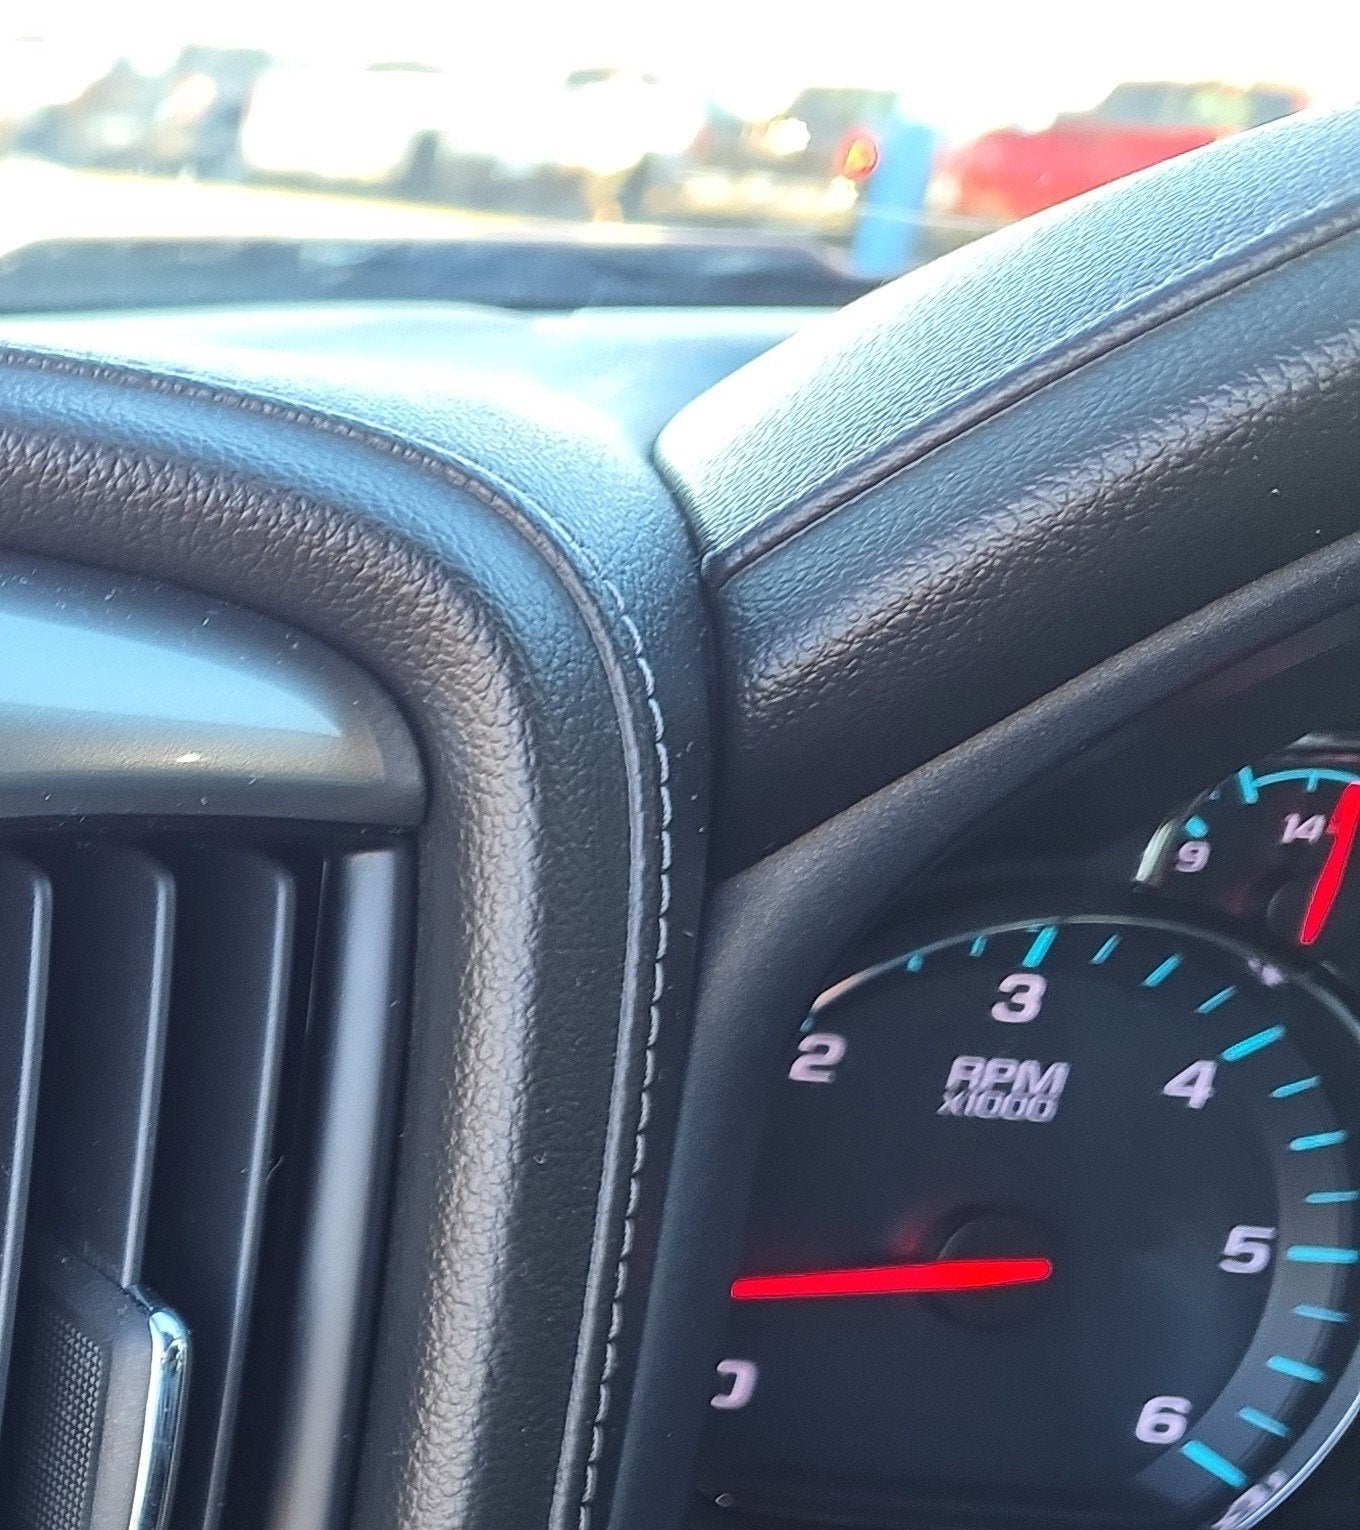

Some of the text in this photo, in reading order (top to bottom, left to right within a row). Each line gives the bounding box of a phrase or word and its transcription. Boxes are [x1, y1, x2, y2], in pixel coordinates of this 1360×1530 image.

[1281, 812, 1326, 844] 14
[1175, 841, 1212, 873] 9
[991, 973, 1047, 1023] 3
[788, 1032, 847, 1082] 2
[944, 1055, 1071, 1099] RPM
[1162, 1060, 1217, 1110] 4
[1218, 1224, 1276, 1274] 5
[1135, 1395, 1193, 1445] 6
